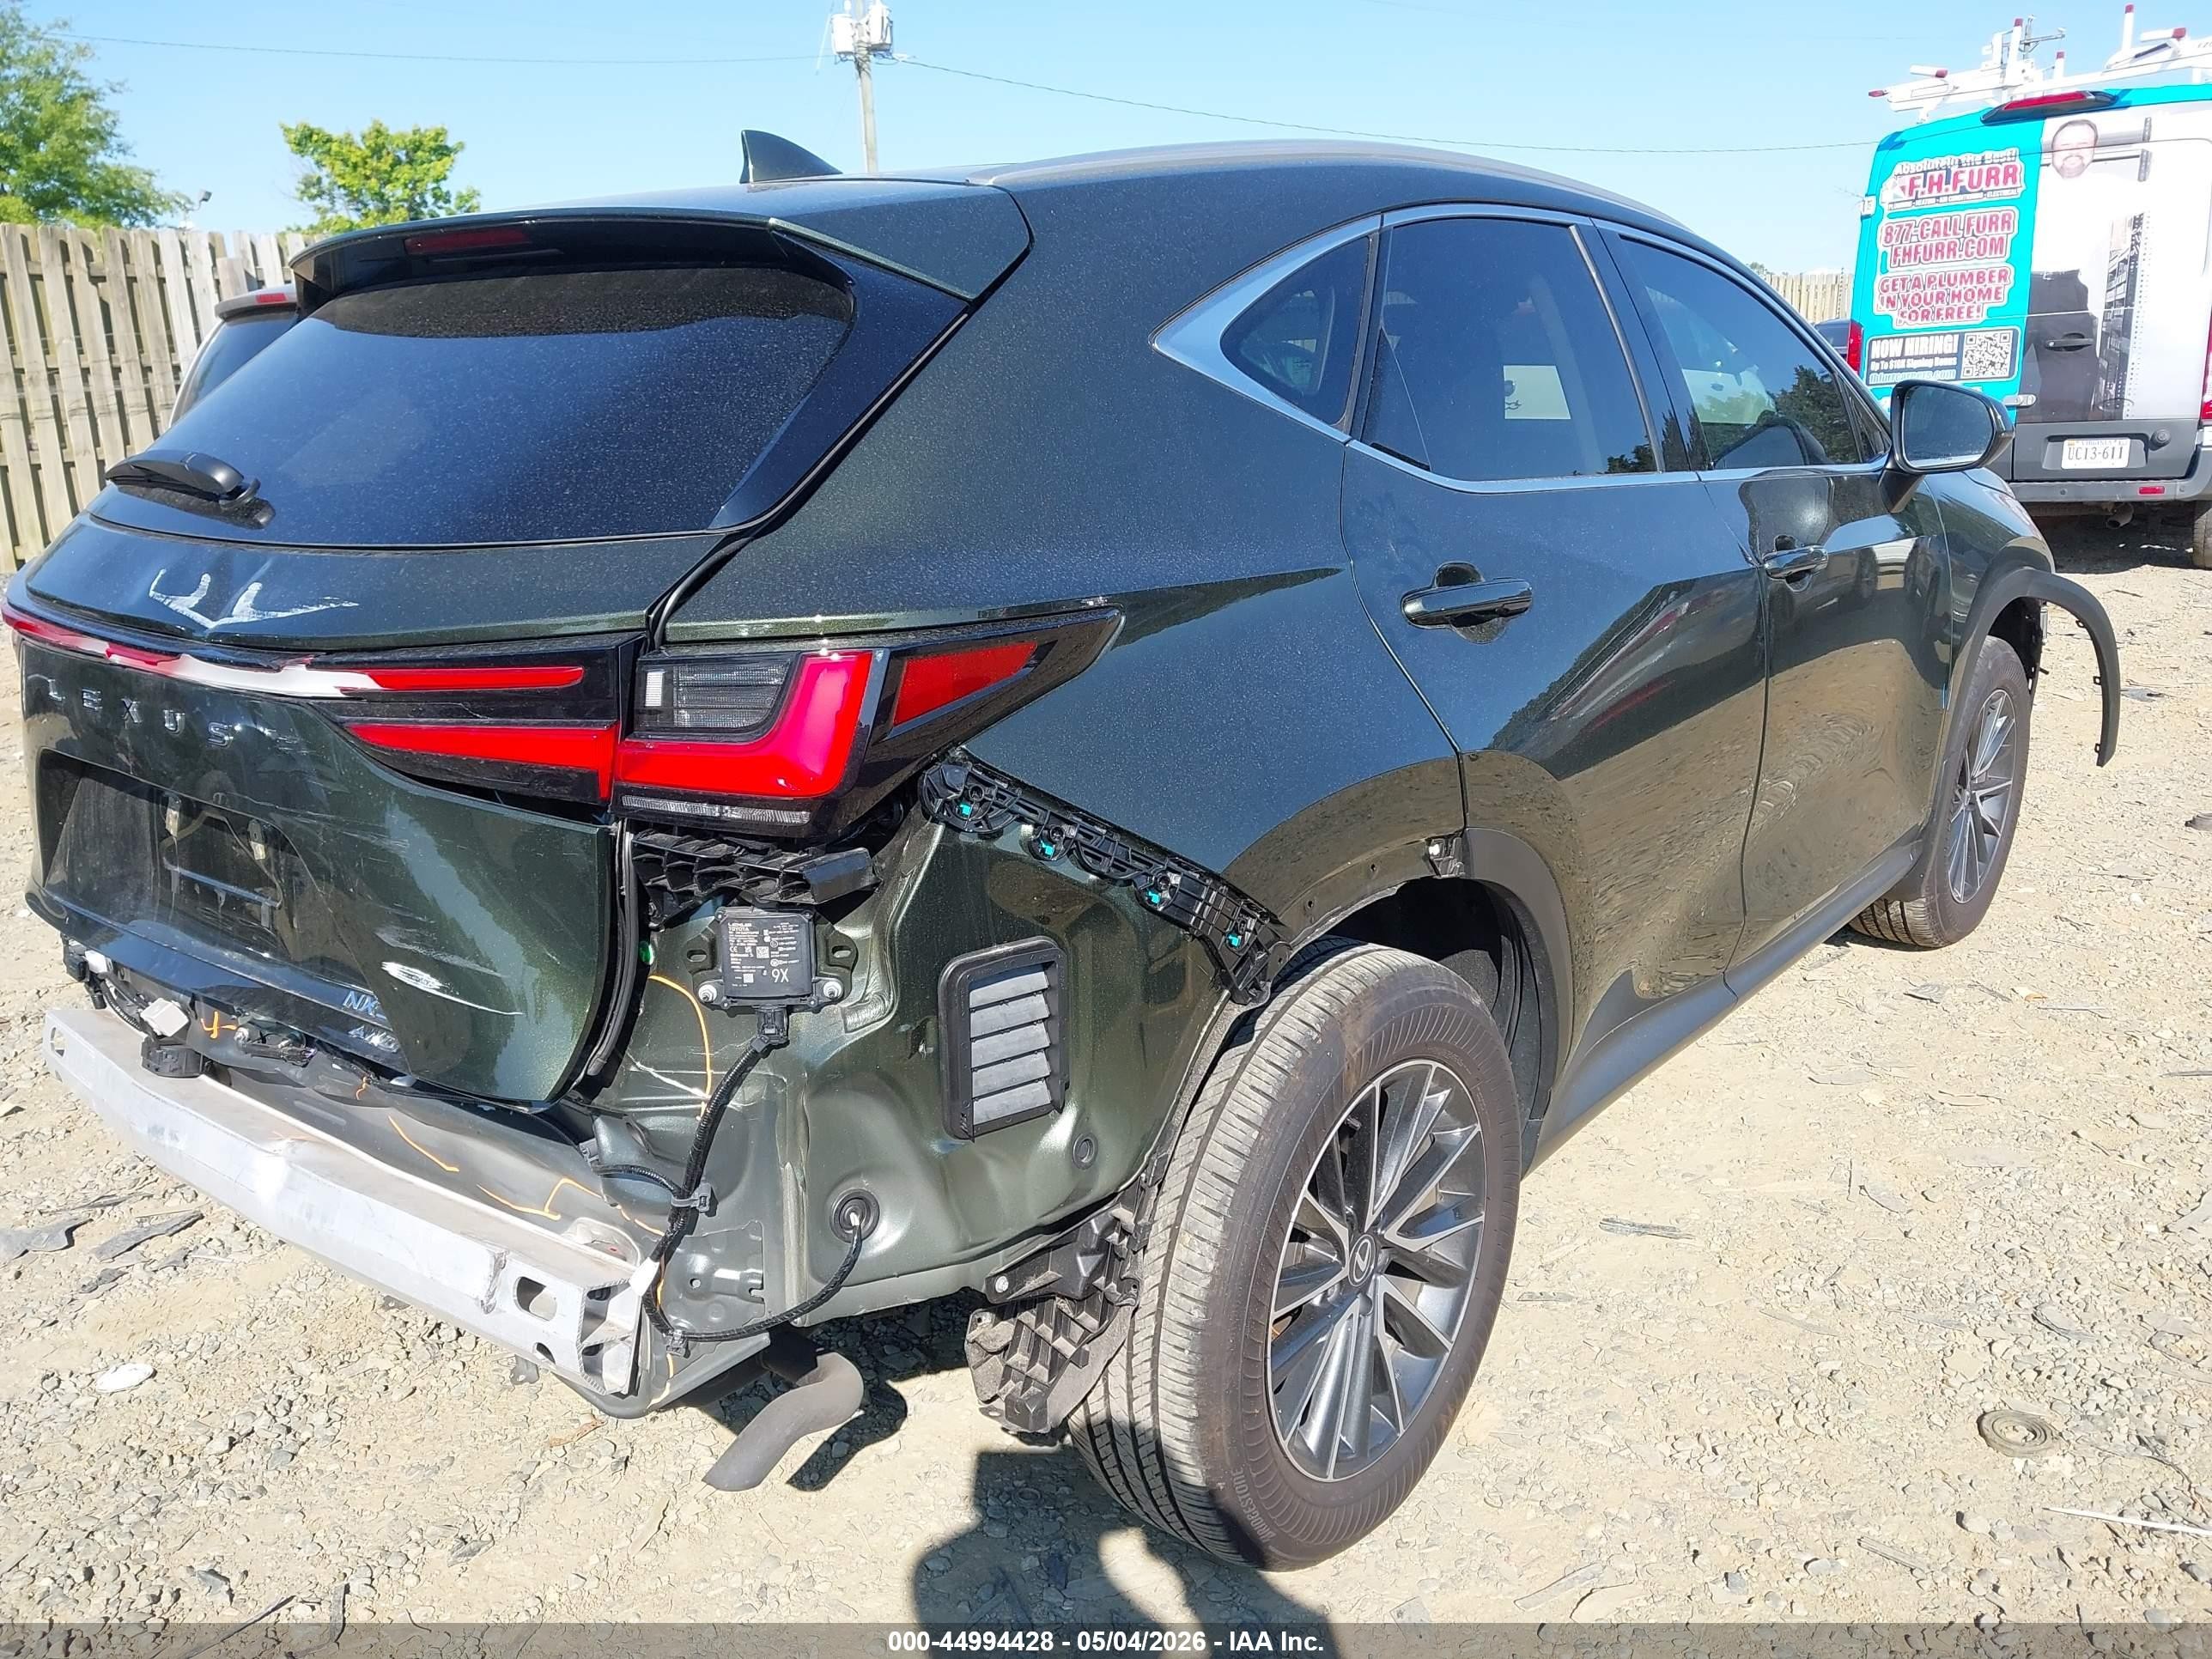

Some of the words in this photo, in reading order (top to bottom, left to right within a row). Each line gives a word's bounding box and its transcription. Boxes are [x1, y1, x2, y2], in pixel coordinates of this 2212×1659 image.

[1894, 155, 1959, 176] Absolutely
[1960, 152, 1982, 166] the
[1884, 216, 1960, 244] 877-CALL
[1965, 212, 2013, 235] FURR
[1893, 236, 2005, 266] FHFURR.COM
[1880, 276, 1909, 294] GET
[1911, 276, 1923, 290] A
[1926, 268, 2009, 289] PLUMBER
[1880, 295, 1897, 309] IN
[1900, 290, 1947, 307] YOUR
[1950, 286, 2002, 302] HOME
[1899, 308, 1932, 323] FOR
[1936, 304, 1983, 321] FREE!
[1871, 338, 1904, 359] NOW
[1905, 334, 1960, 356] HIRING!
[1871, 362, 1880, 371] Up
[1881, 361, 1889, 370] To
[1906, 356, 1934, 369] Signing
[1934, 356, 1958, 366] Bonus
[2068, 446, 2124, 460] UC13-611
[48, 678, 234, 749] LEXUS
[771, 968, 789, 983] 9X
[1231, 1465, 1277, 1543] BRIDGESTONE
